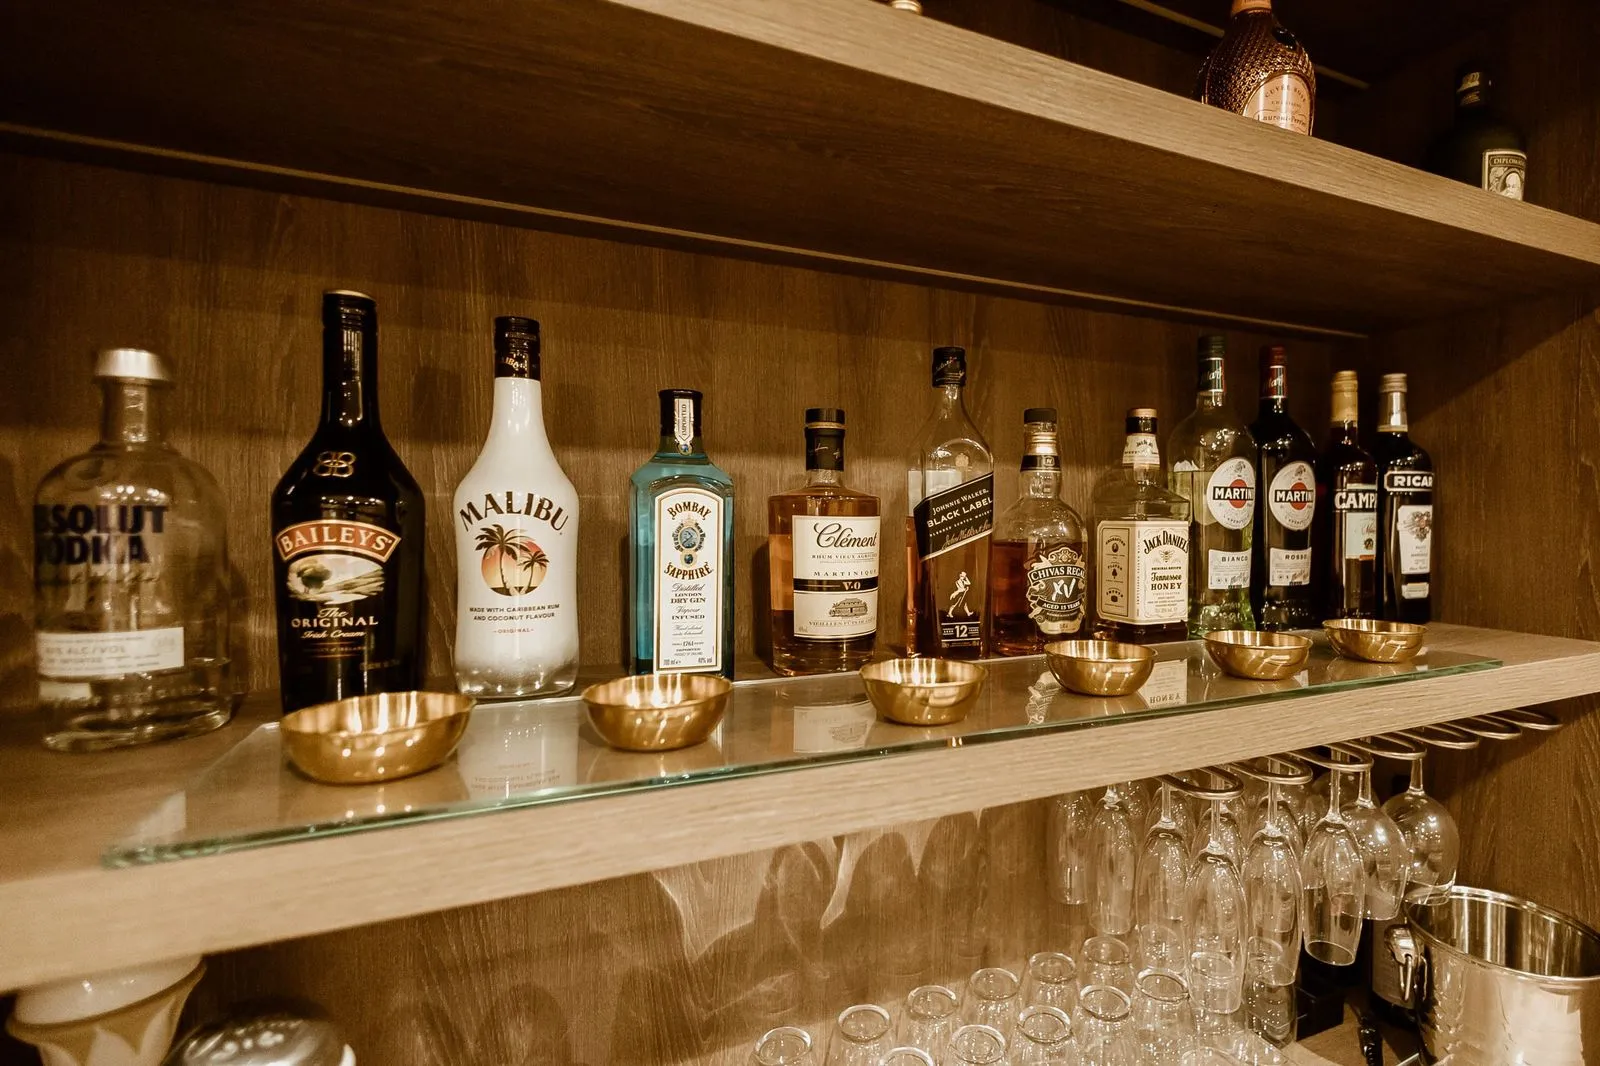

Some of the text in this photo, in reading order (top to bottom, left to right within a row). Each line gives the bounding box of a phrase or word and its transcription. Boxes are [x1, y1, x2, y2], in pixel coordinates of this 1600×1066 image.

[459, 491, 570, 533] MALIBU
[667, 501, 712, 520] BOMBAY
[926, 508, 961, 528] BLACK
[962, 496, 993, 515] LABEL
[932, 498, 961, 516] JOHNNIE
[279, 525, 388, 553] BAILEYS
[813, 522, 878, 548] Clément
[1143, 534, 1162, 555] JACK
[1221, 555, 1249, 563] BIANCO
[663, 561, 715, 580] SAPPHIRE
[1030, 566, 1065, 581] CHIVAS
[1150, 571, 1183, 582] Tennessee
[671, 582, 706, 593] Distilled
[1051, 577, 1077, 602] XV
[1150, 582, 1183, 591] HONEY
[317, 606, 349, 619] The
[506, 605, 546, 613] CARIBBEAN
[291, 615, 379, 628] ORIGINAL
[525, 612, 555, 621] FLAVOUR
[301, 630, 367, 640] Irish Cream
[954, 625, 968, 638] 12
